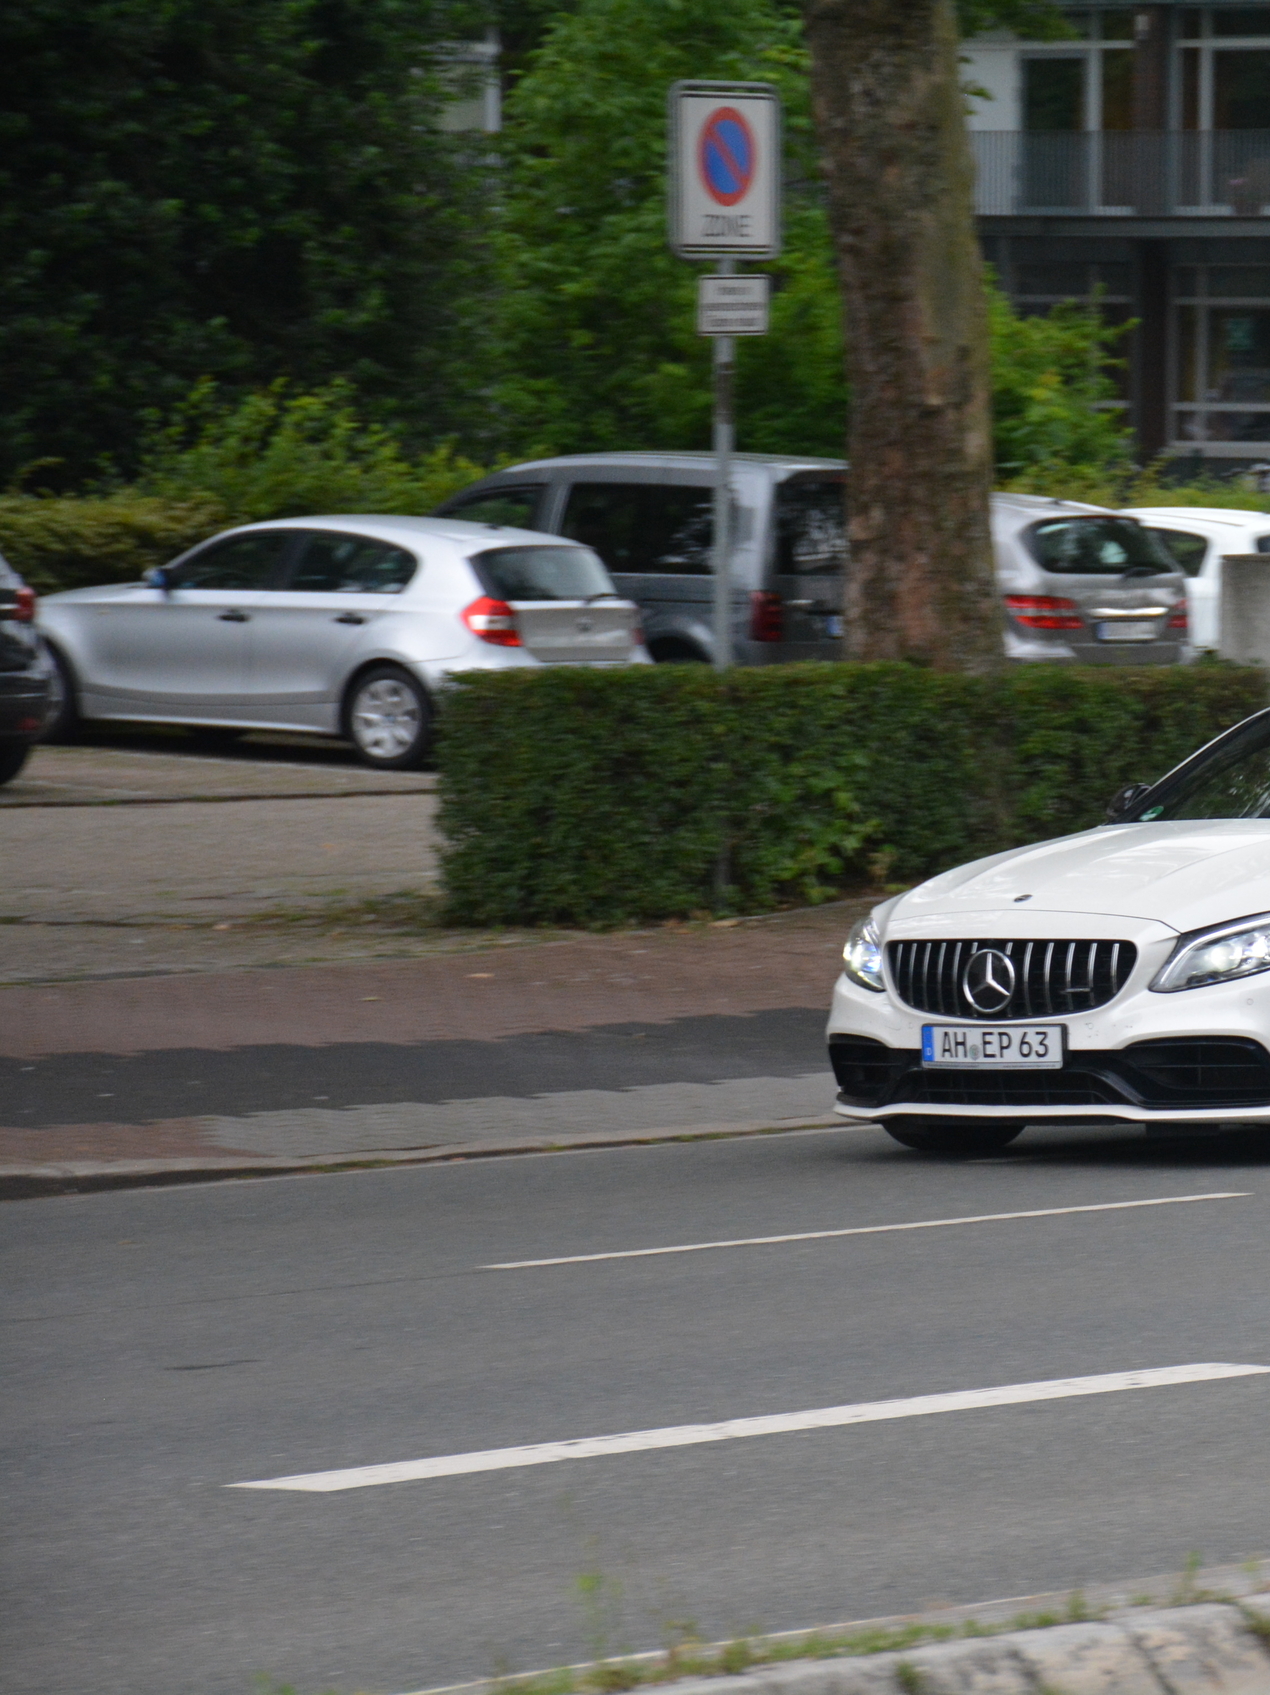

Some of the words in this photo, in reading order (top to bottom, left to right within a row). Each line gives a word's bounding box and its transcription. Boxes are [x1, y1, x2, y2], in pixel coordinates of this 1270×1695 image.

[701, 214, 752, 237] ZONE
[927, 1048, 932, 1056] D
[941, 1031, 967, 1058] AH
[982, 1031, 1012, 1058] EP
[1019, 1031, 1049, 1058] 63
